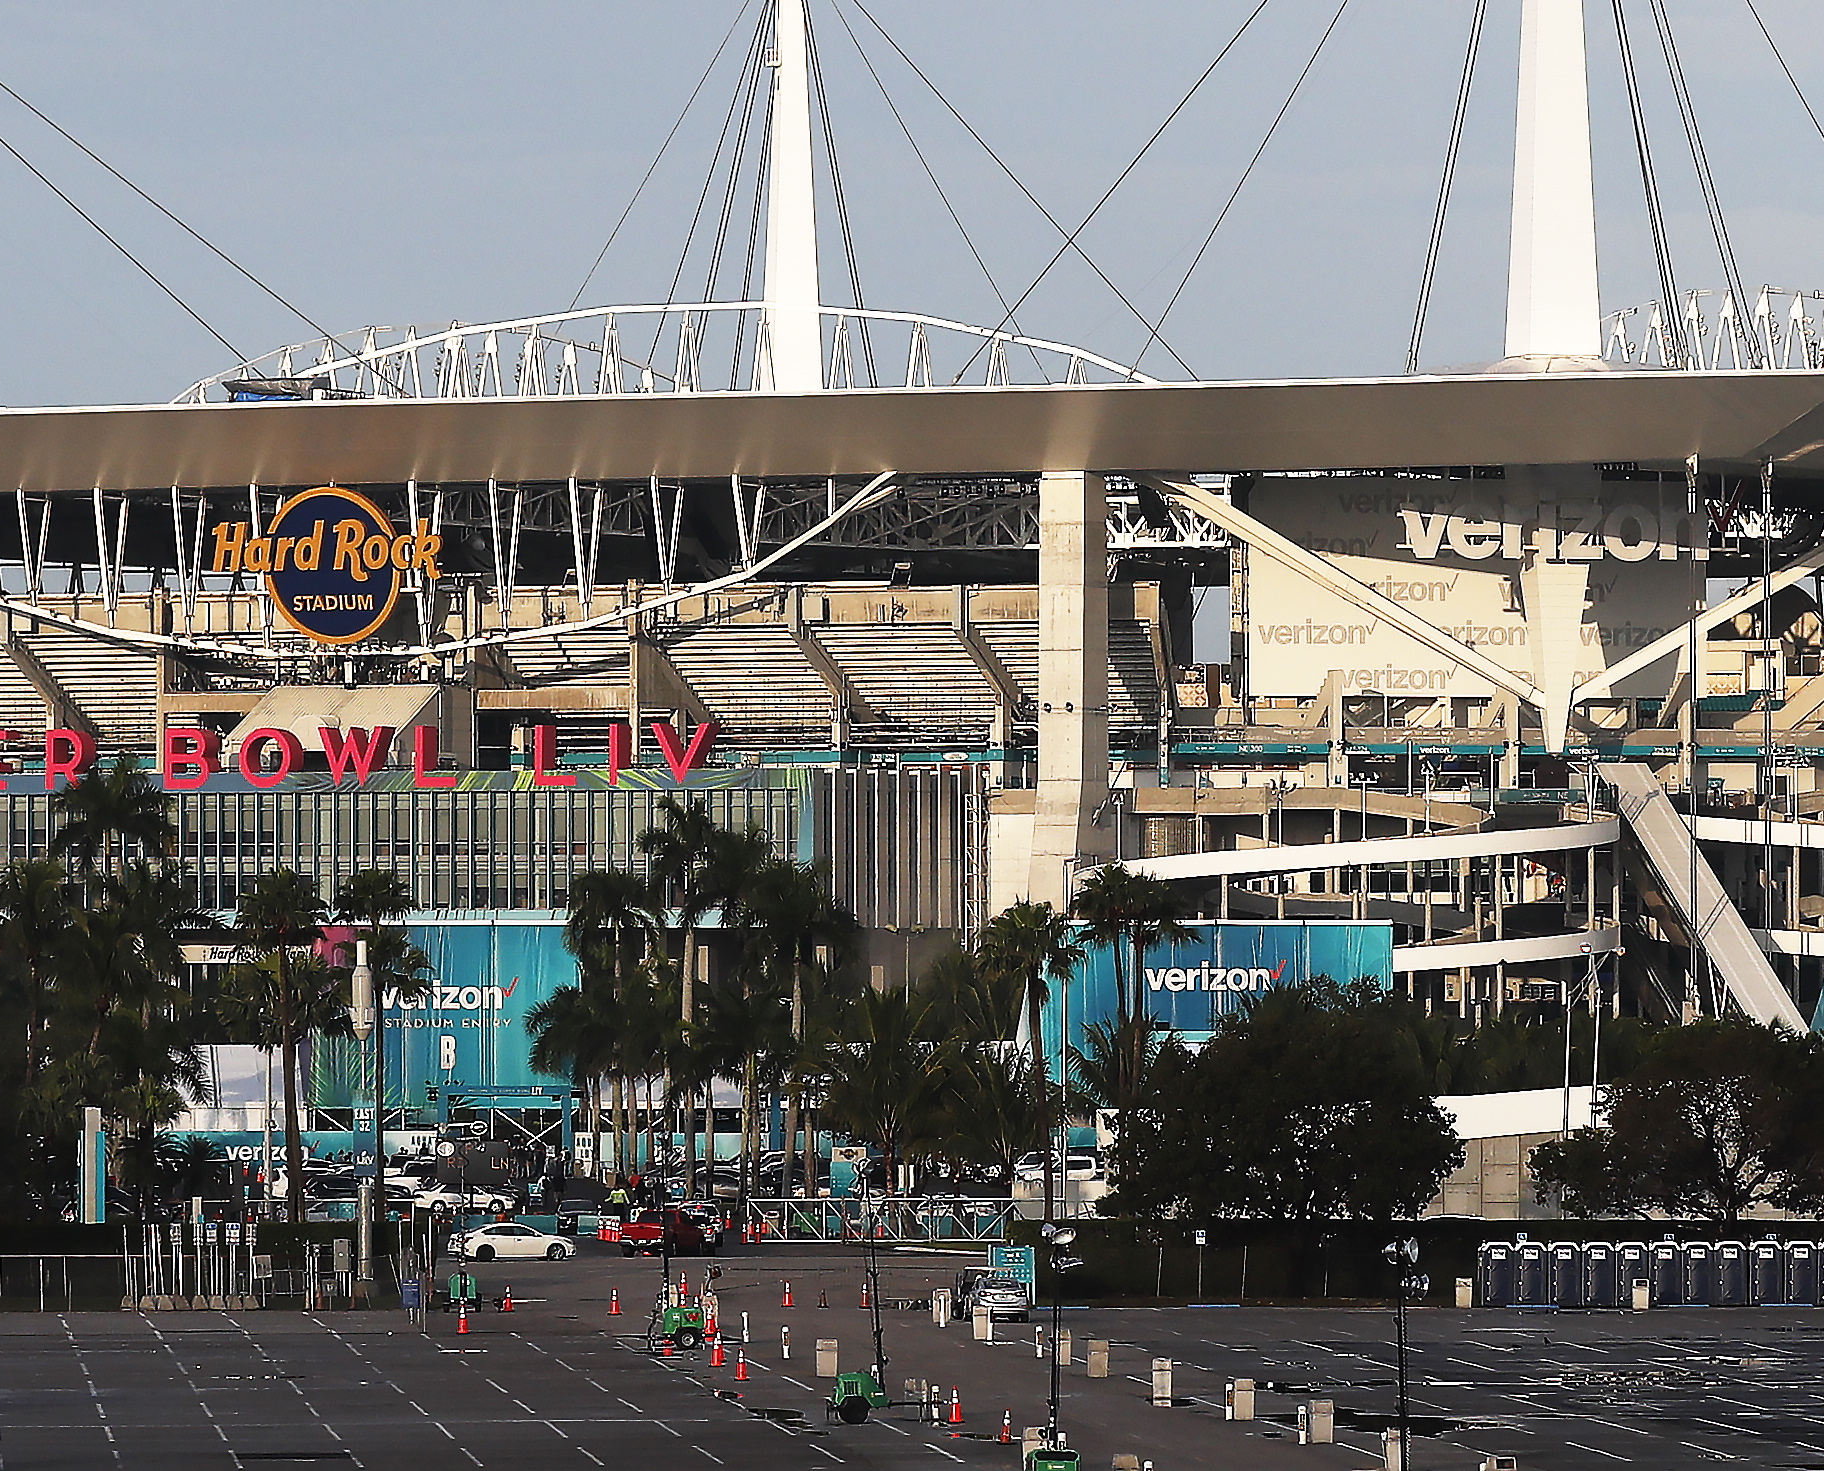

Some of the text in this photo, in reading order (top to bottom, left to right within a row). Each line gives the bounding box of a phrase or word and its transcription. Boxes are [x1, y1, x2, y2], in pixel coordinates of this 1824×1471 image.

[1399, 498, 1711, 561] verizon
[212, 518, 443, 581] Hard Rock
[293, 594, 373, 611] STADIUM
[1258, 618, 1366, 645] verizon
[1438, 620, 1525, 646] erizon
[1342, 663, 1446, 689] verizon
[163, 725, 457, 790] BOWL
[534, 723, 717, 785] LIV
[1145, 960, 1271, 991] verizon
[382, 979, 503, 1009] verizon
[384, 1018, 511, 1028] STADIUM ENTRY
[440, 1036, 456, 1069] B
[354, 1108, 375, 1119] EAST
